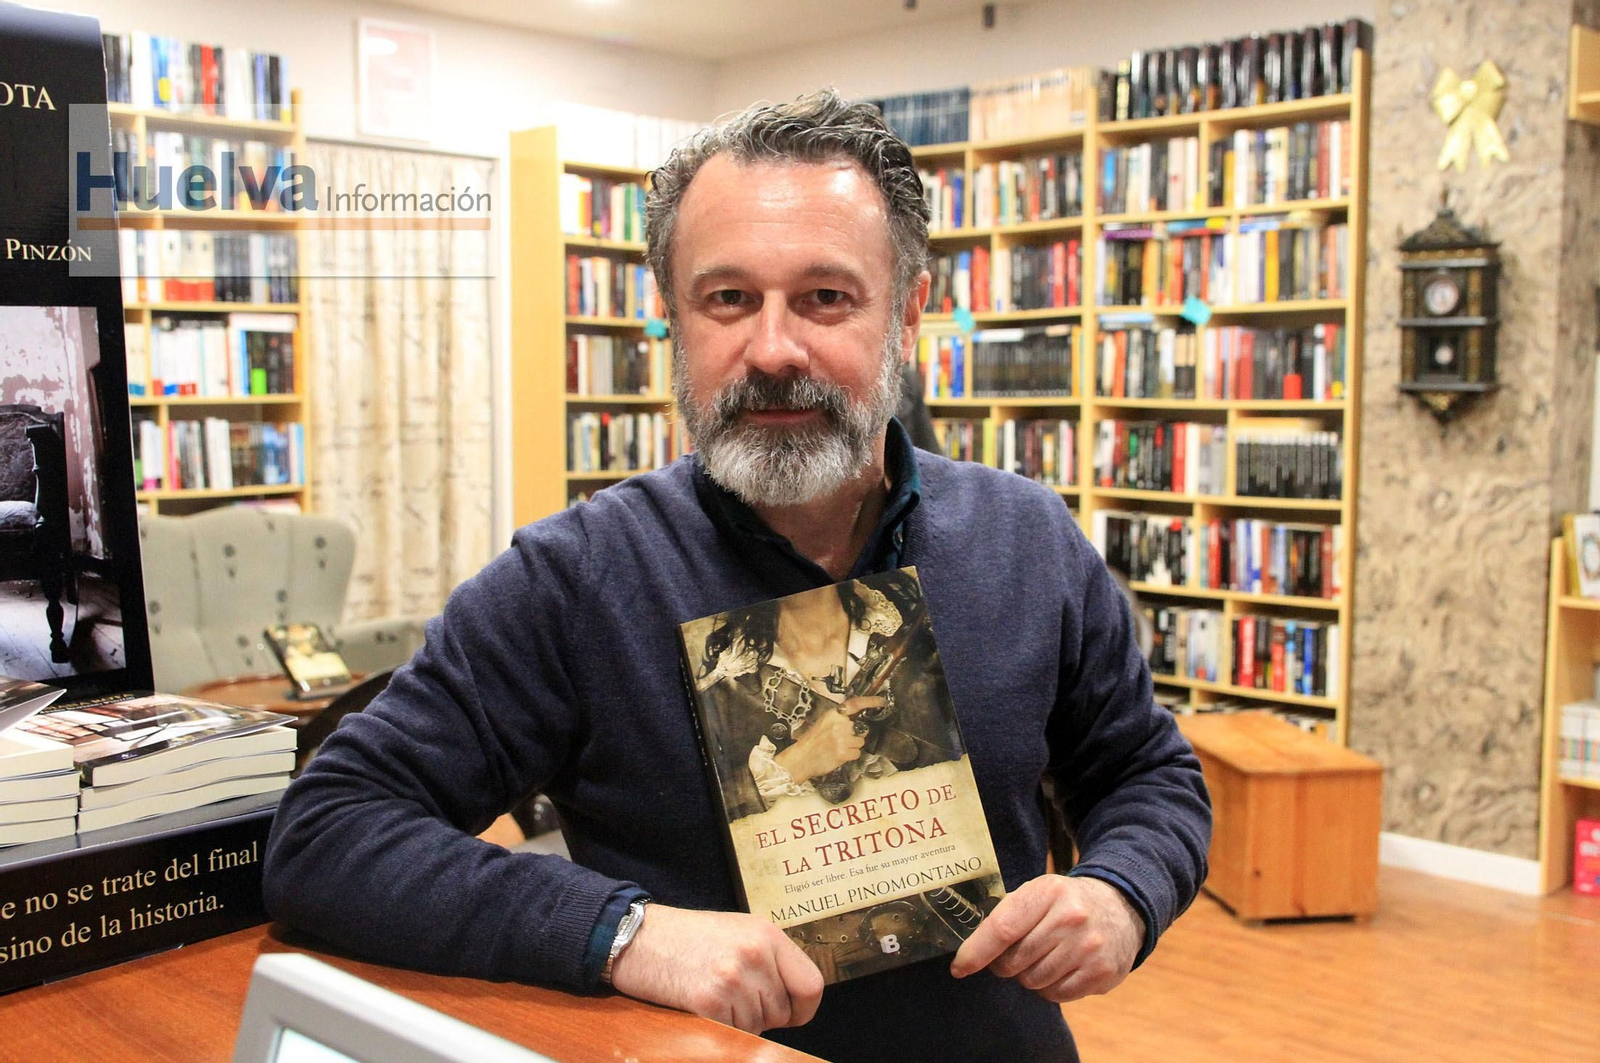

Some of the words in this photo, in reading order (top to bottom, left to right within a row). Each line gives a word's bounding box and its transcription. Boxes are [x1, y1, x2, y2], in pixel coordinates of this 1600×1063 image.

[755, 828, 787, 849] EL
[790, 789, 920, 840] SECRETO
[926, 784, 957, 806] DE
[782, 856, 813, 876] LA
[814, 816, 948, 867] TRITONA
[25, 892, 58, 915] no
[67, 884, 94, 905] se
[102, 869, 156, 896] trate
[164, 853, 200, 882] del
[208, 840, 258, 872] final
[770, 893, 845, 923] MANUEL
[847, 856, 982, 903] PINOMONTANO
[784, 879, 810, 894] Eligió
[811, 878, 824, 887] ser
[826, 873, 848, 884] libre.
[849, 867, 865, 878] Esa
[866, 863, 879, 873] fue
[881, 861, 891, 870] su
[892, 854, 919, 868] mayor
[920, 844, 956, 860] aventura
[61, 922, 92, 948] de
[100, 914, 122, 938] la
[130, 891, 224, 931] historia.
[880, 933, 901, 954] B
